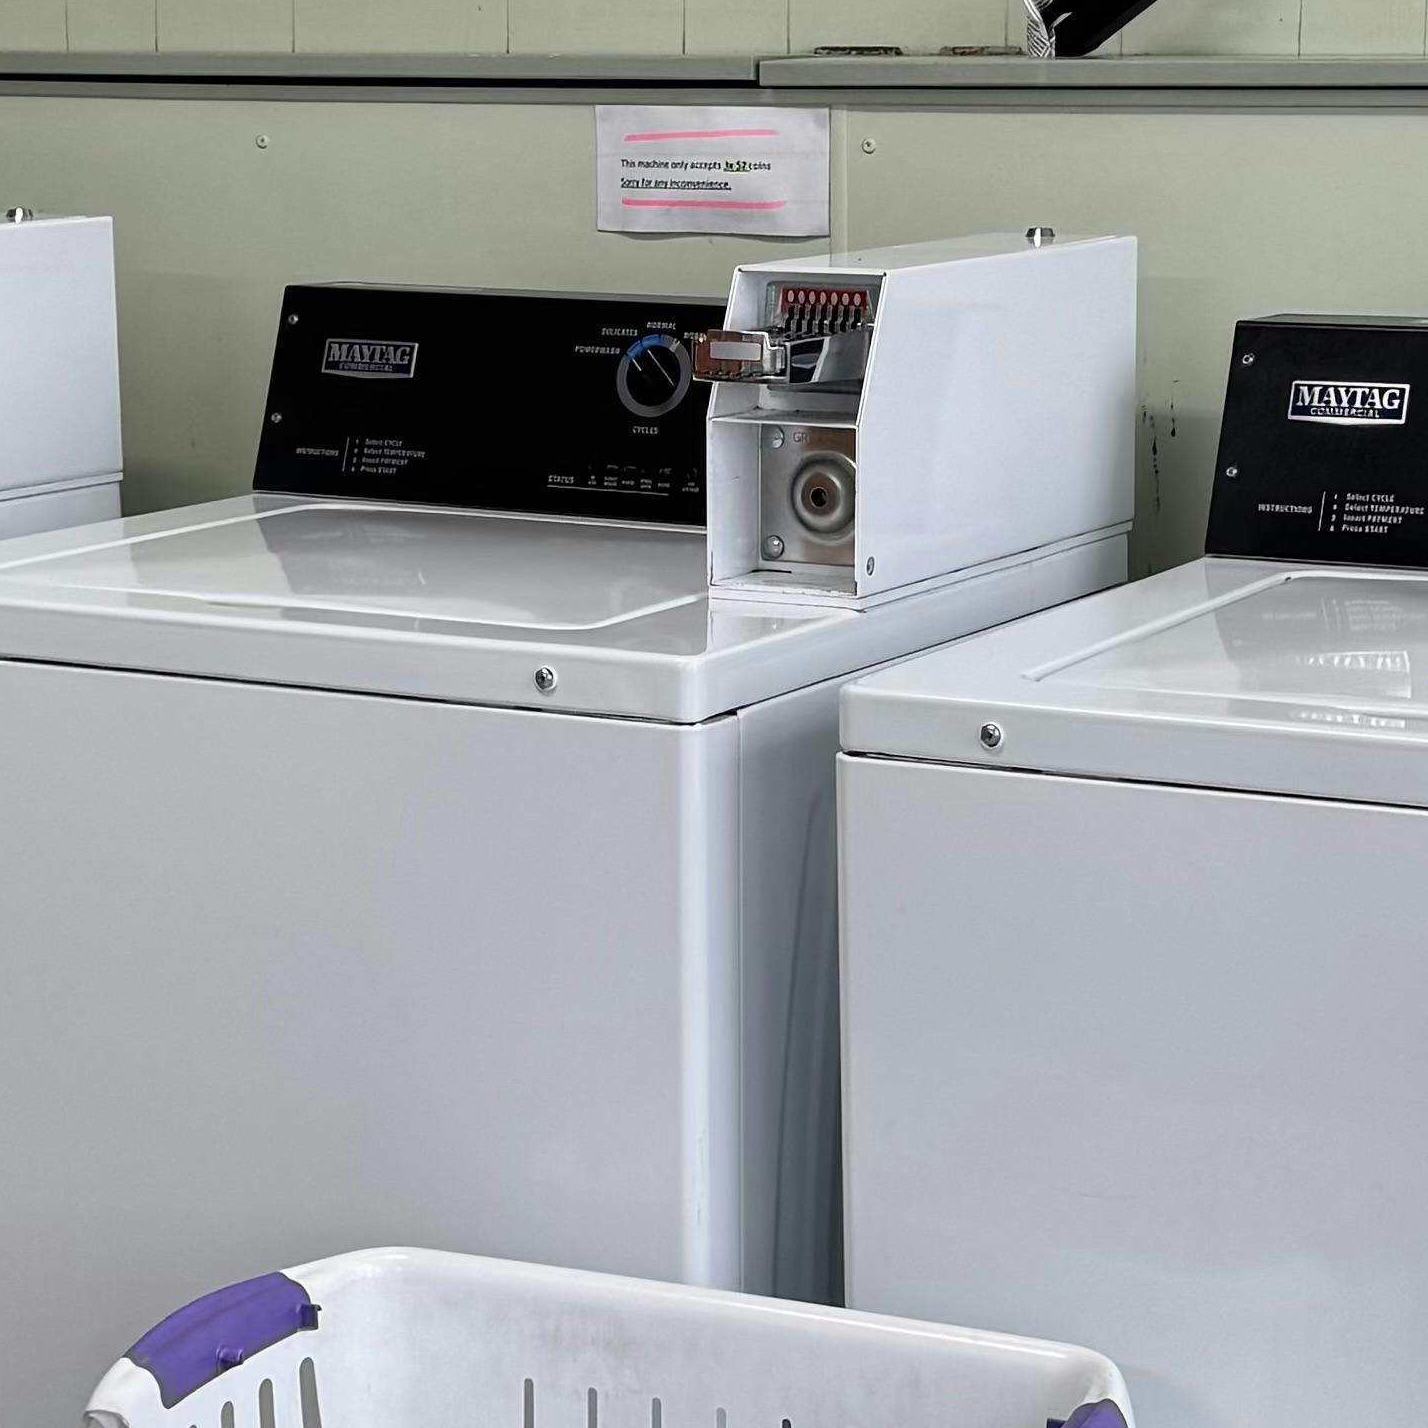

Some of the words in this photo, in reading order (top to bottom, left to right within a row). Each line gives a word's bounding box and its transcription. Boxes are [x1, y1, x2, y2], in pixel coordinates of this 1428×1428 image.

[620, 159, 636, 169] This
[637, 160, 669, 169] machine
[671, 160, 688, 171] only
[690, 161, 721, 172] accepts
[620, 177, 639, 189] Sorry
[641, 178, 652, 188] for
[328, 342, 411, 365] MAYTAG
[1295, 385, 1401, 410] MAYTAG
[1310, 407, 1380, 418] COMMERCIAL
